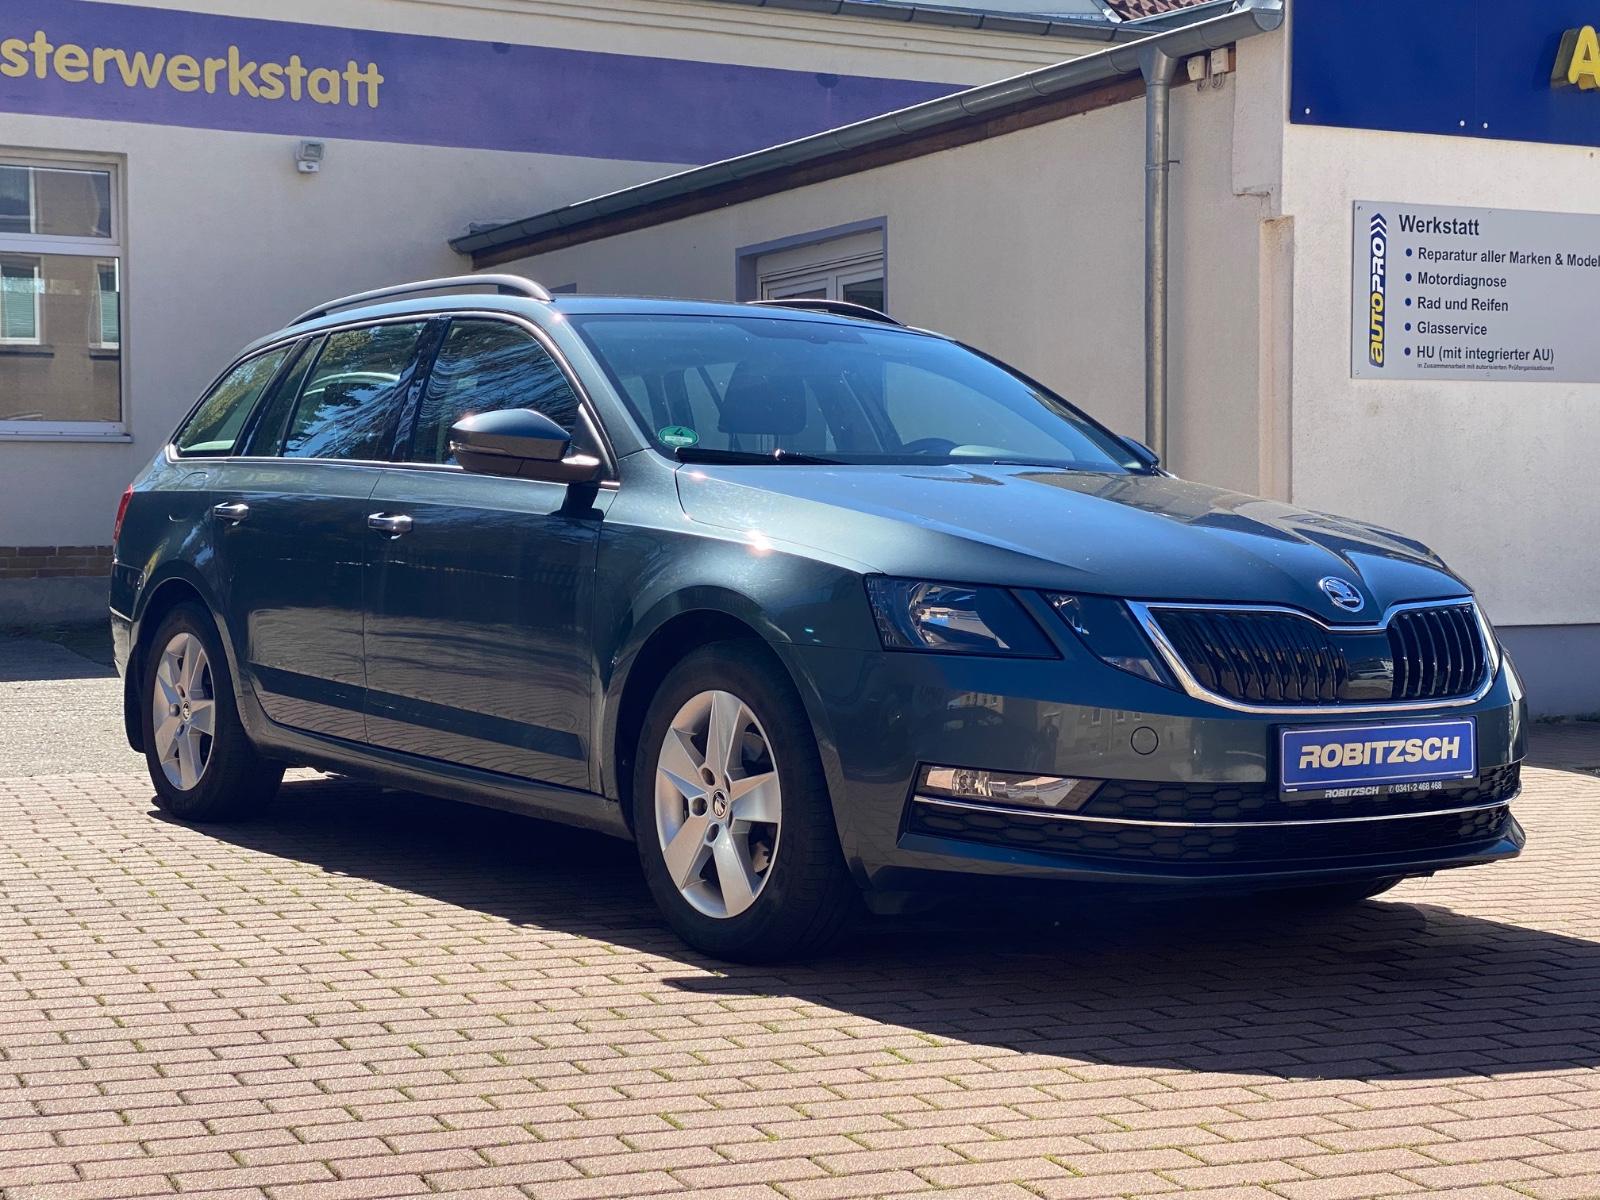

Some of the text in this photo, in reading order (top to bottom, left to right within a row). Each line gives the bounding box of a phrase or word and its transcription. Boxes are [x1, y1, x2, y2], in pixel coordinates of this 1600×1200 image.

[0, 30, 384, 108] sterwerkstatt
[1399, 214, 1480, 236] Werkstatt
[1418, 247, 1478, 263] Reparatur
[1480, 250, 1507, 263] aller
[1509, 251, 1551, 265] Marken
[1555, 253, 1563, 266] &
[1418, 272, 1507, 290] Motordiagnose
[1417, 297, 1509, 312] Rad und Reifen
[1417, 321, 1488, 335] Glasservice
[1416, 346, 1554, 364] HU (mit integrierter AU)
[1424, 362, 1466, 370] Zusammenarbeit
[1299, 736, 1461, 770] ROBITZSCH
[1325, 786, 1380, 799] ROBITZSCH
